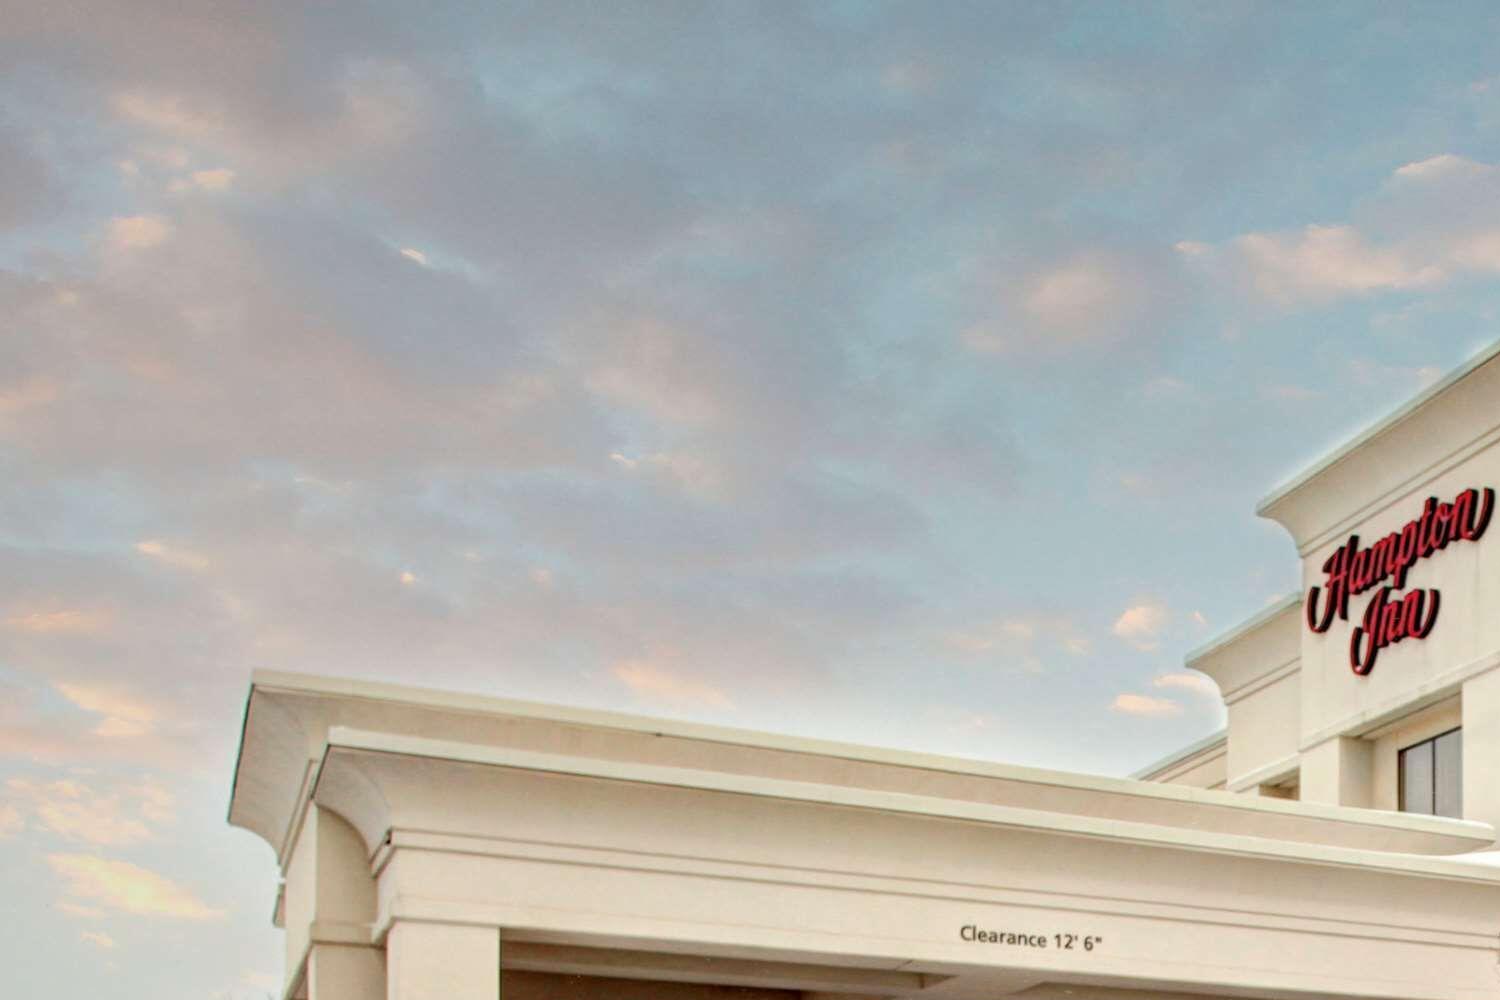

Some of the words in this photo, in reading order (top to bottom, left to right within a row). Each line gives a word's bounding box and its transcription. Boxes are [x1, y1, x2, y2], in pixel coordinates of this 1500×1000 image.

[1307, 487, 1495, 633] Hampton
[1350, 585, 1440, 676] Inn
[960, 925, 1047, 948] Clearance
[1054, 933, 1078, 950] 12'
[1084, 935, 1102, 951] 6"
